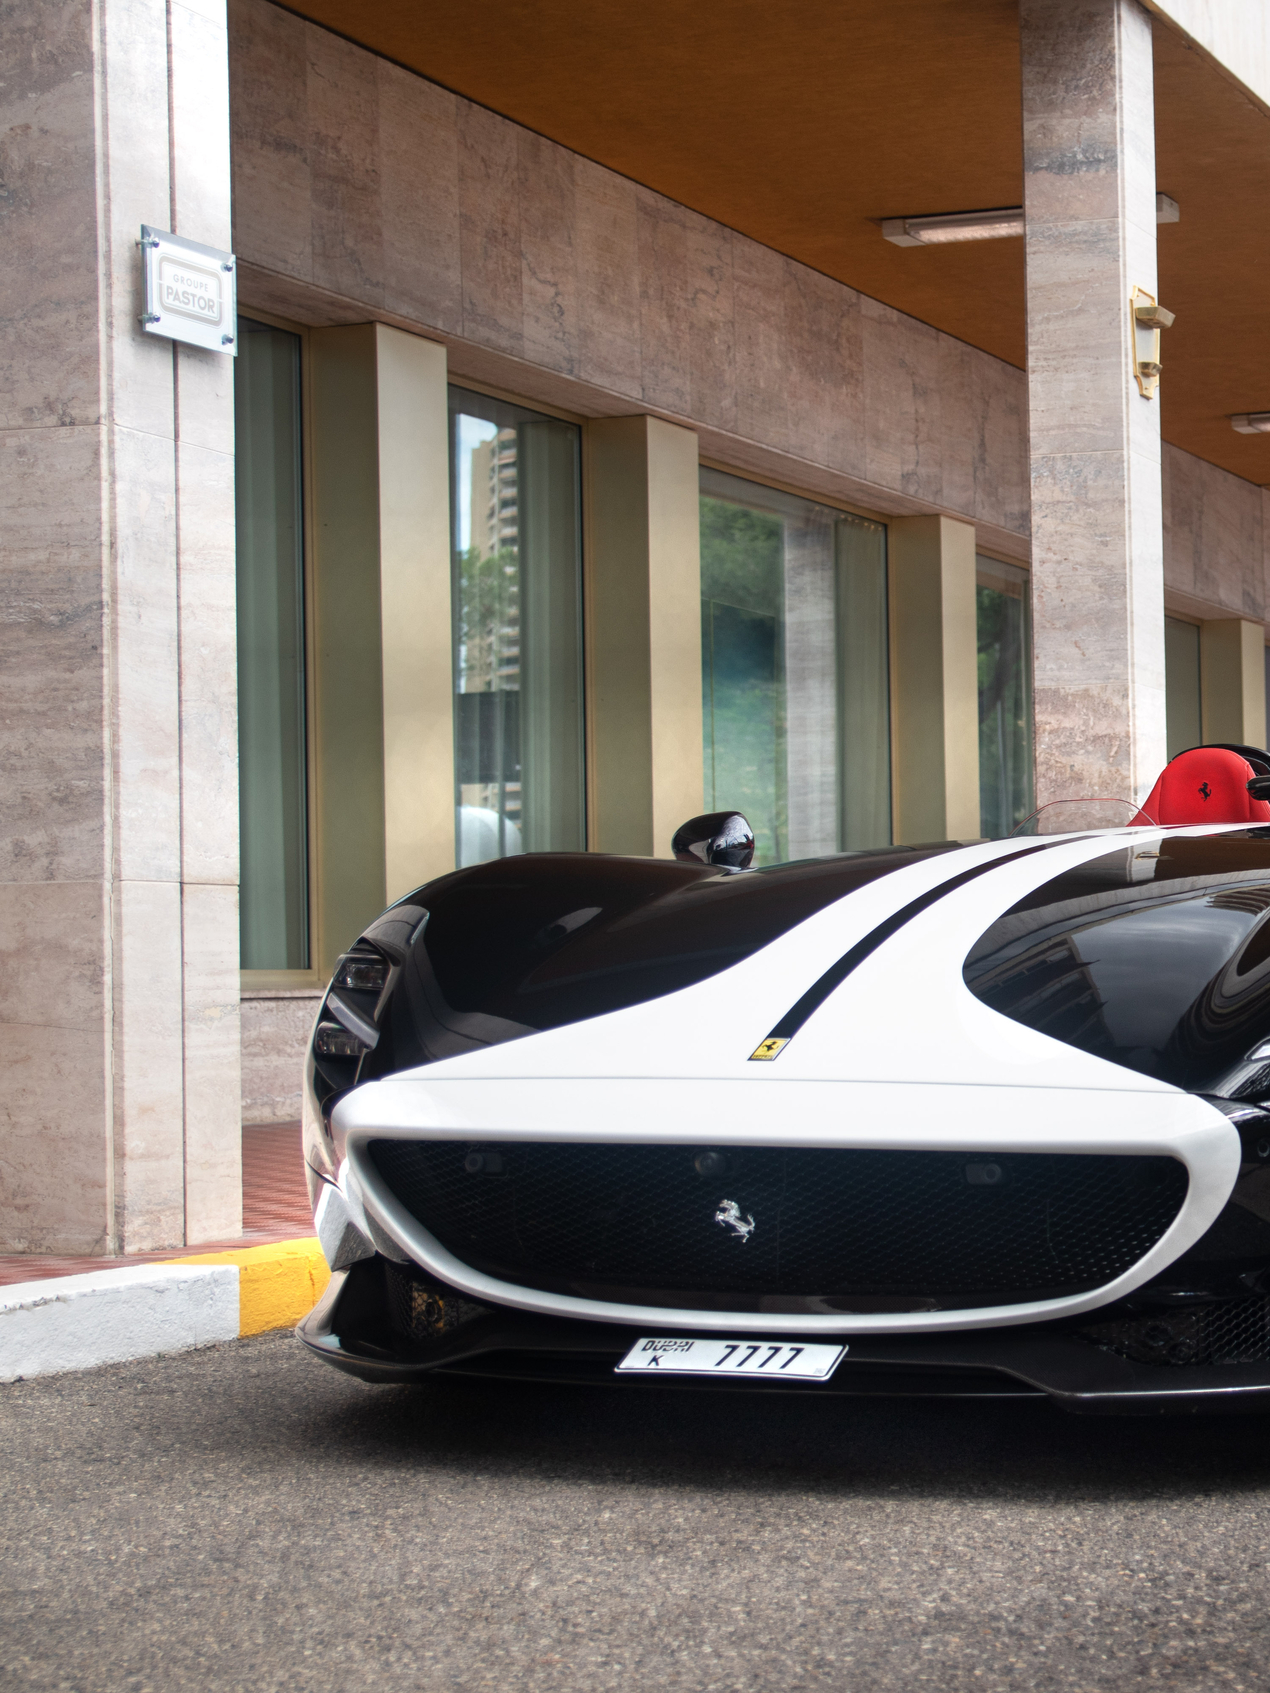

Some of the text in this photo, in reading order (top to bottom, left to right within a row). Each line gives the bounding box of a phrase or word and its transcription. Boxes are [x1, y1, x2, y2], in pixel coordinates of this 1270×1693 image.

[173, 274, 208, 292] GROUPE
[166, 285, 216, 314] PASTOR
[647, 1344, 805, 1370] K 7777
